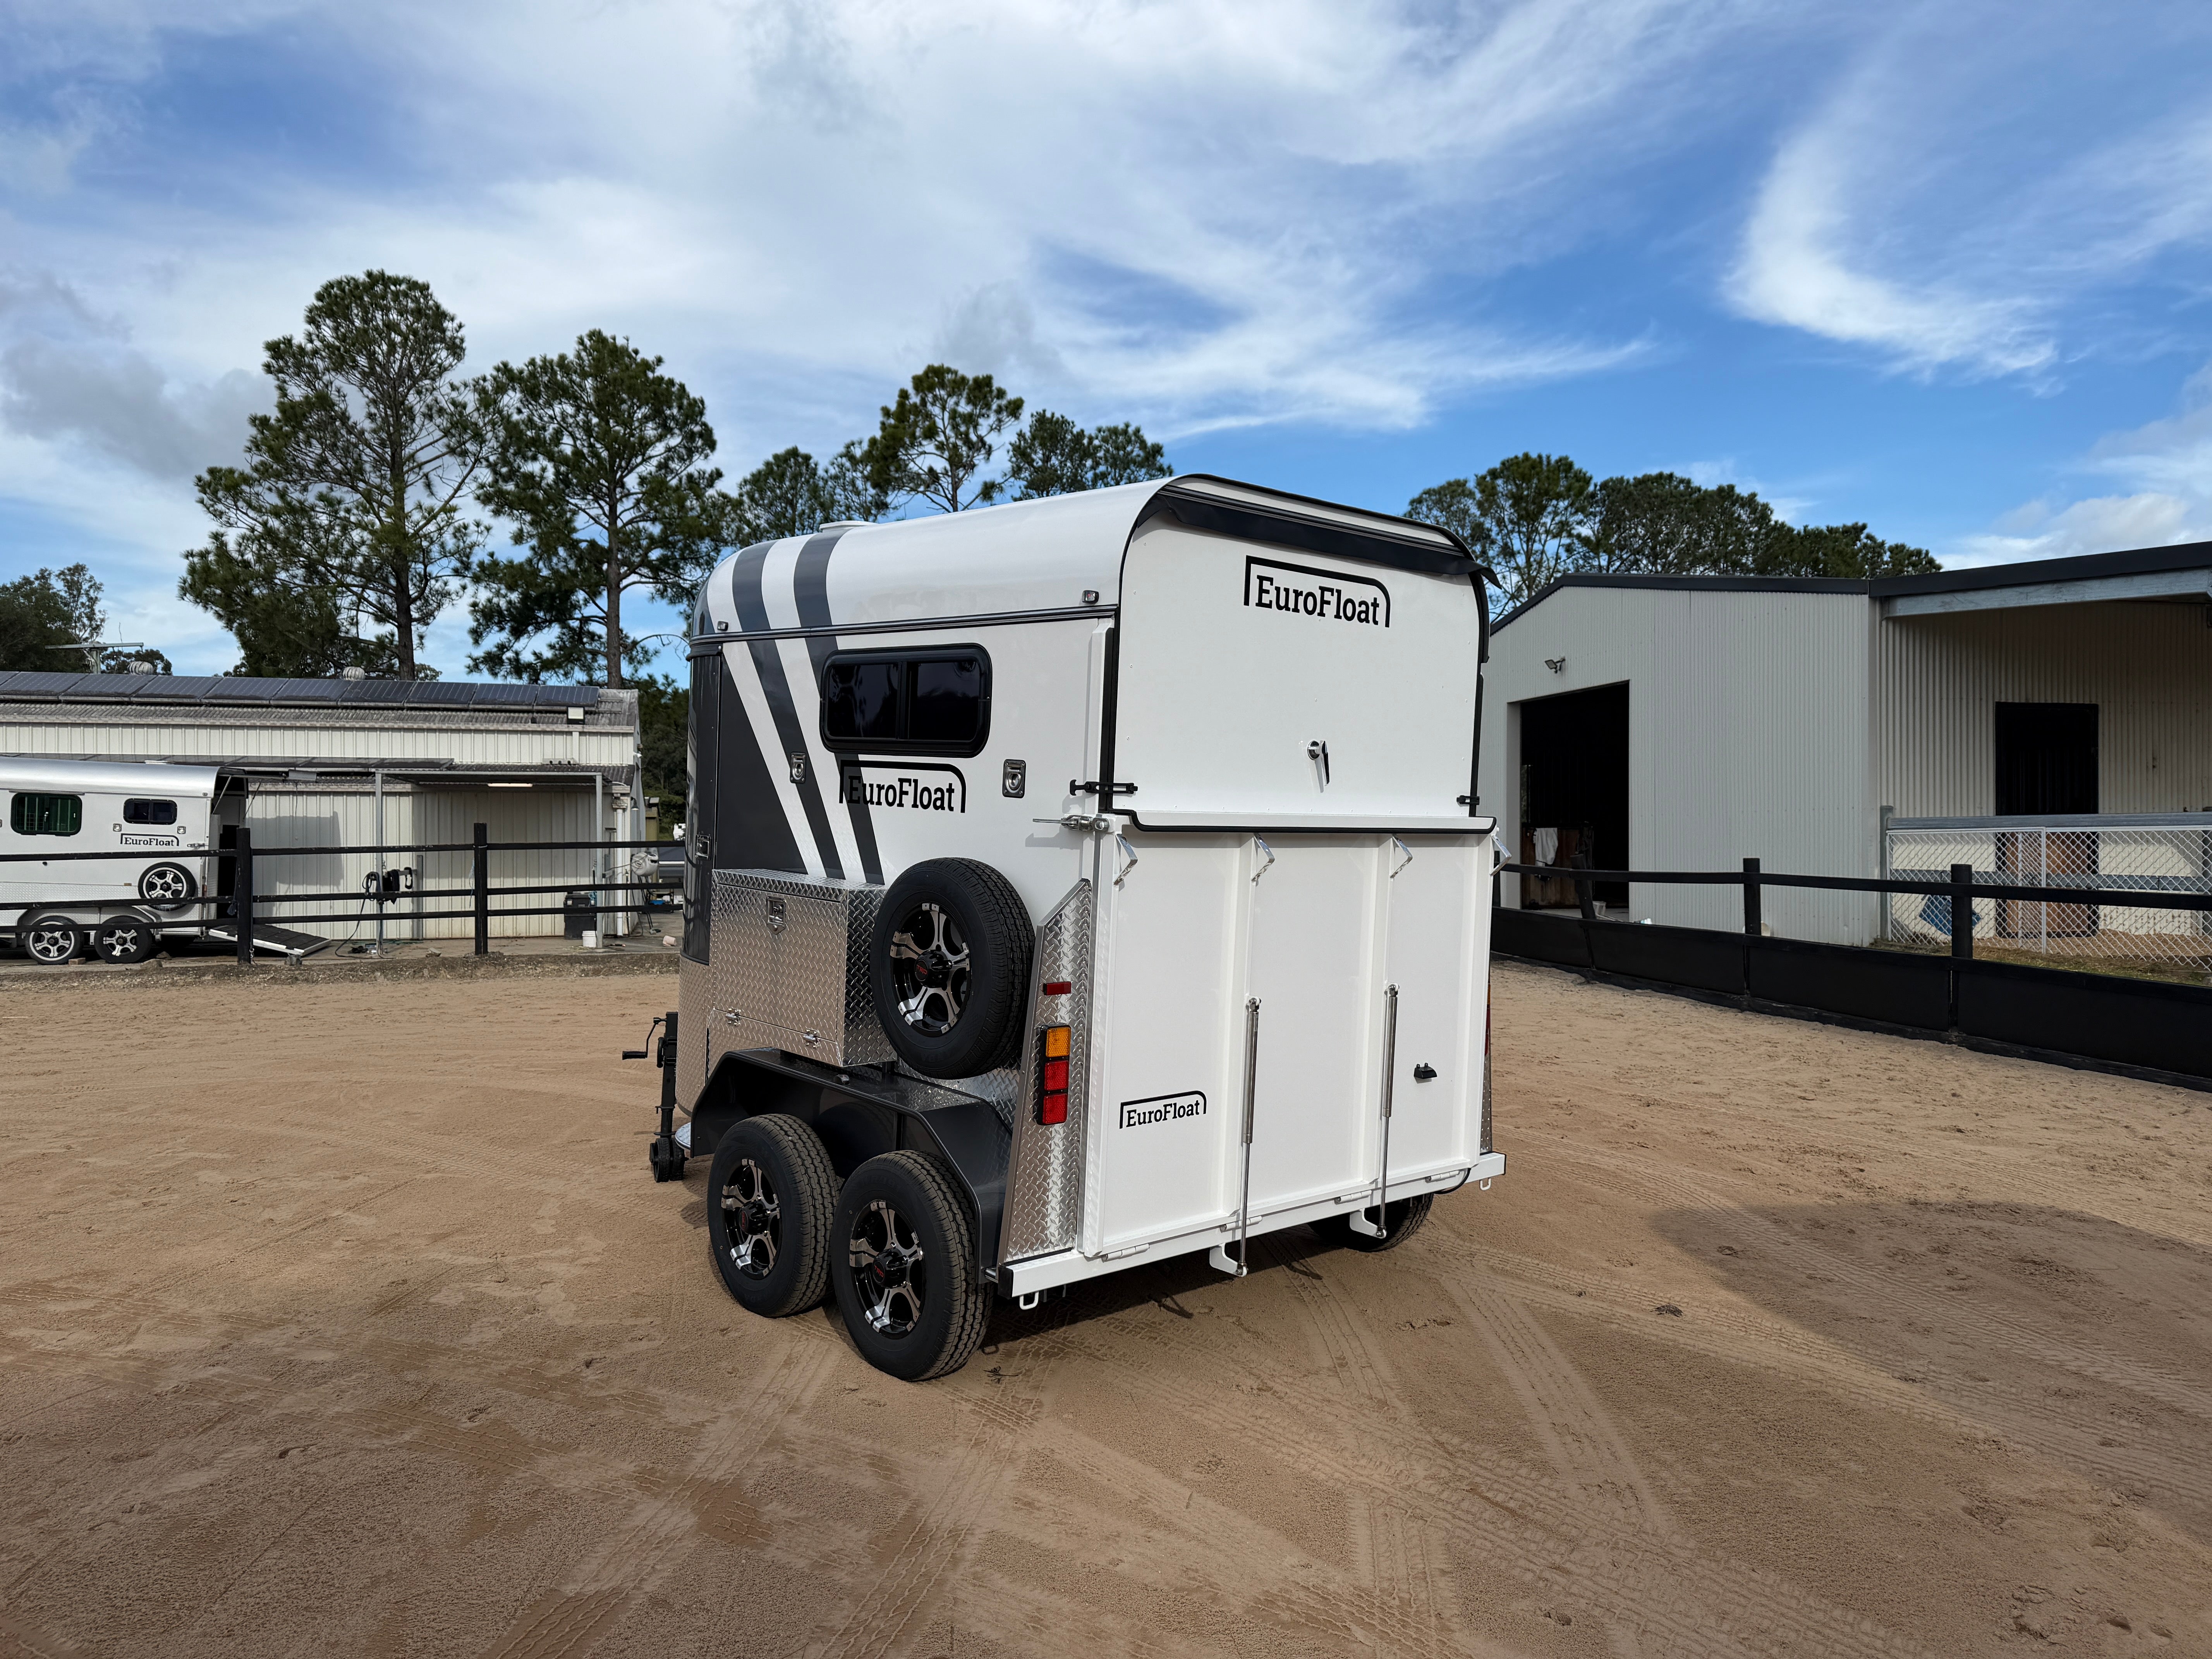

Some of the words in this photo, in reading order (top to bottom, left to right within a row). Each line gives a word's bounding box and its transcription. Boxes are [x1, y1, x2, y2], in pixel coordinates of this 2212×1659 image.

[1255, 575, 1379, 625] EuroFloat
[847, 775, 955, 811] EuroFloat
[124, 837, 174, 846] EuroFloat
[1126, 1100, 1200, 1128] EuroFloat
